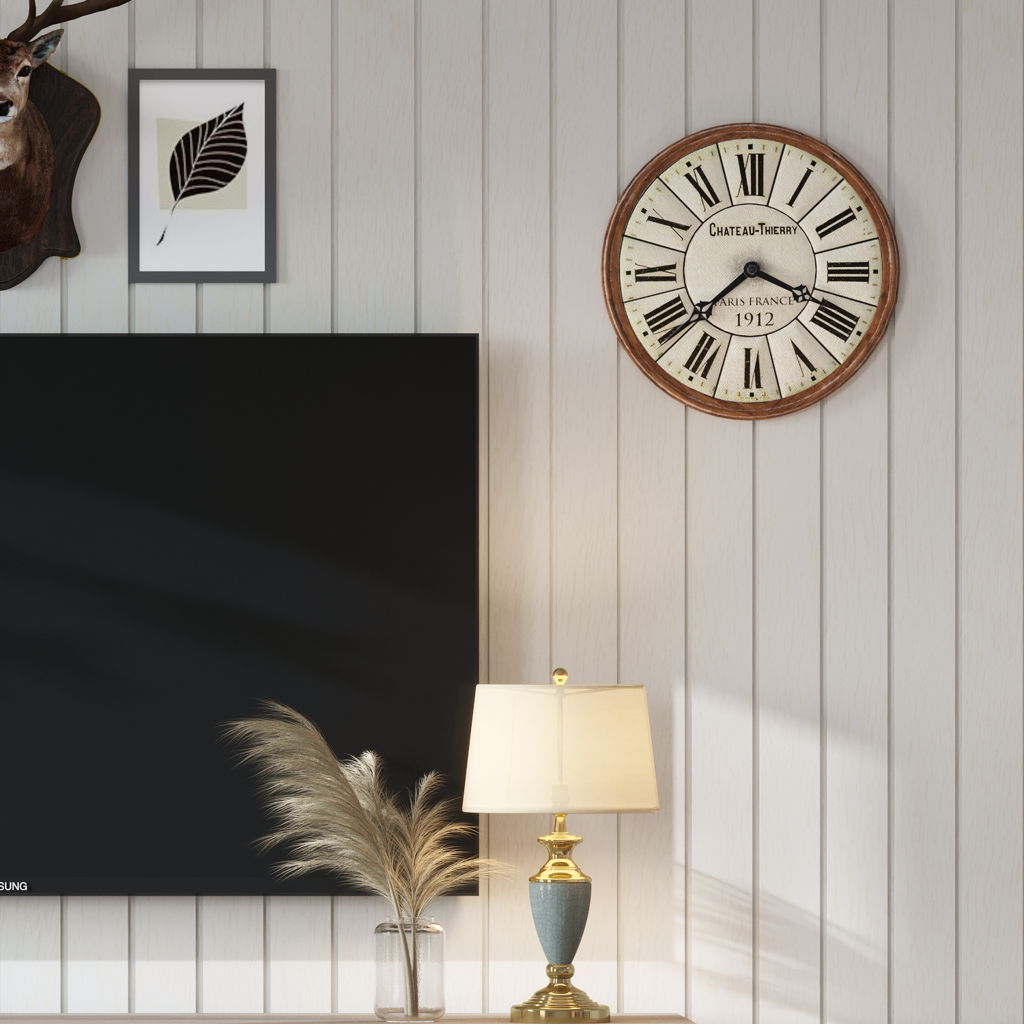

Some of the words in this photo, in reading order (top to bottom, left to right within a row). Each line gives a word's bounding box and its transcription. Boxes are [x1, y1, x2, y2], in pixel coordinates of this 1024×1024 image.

[714, 298, 745, 306] ARIS
[749, 296, 794, 306] FRANCE
[736, 312, 774, 327] 1912
